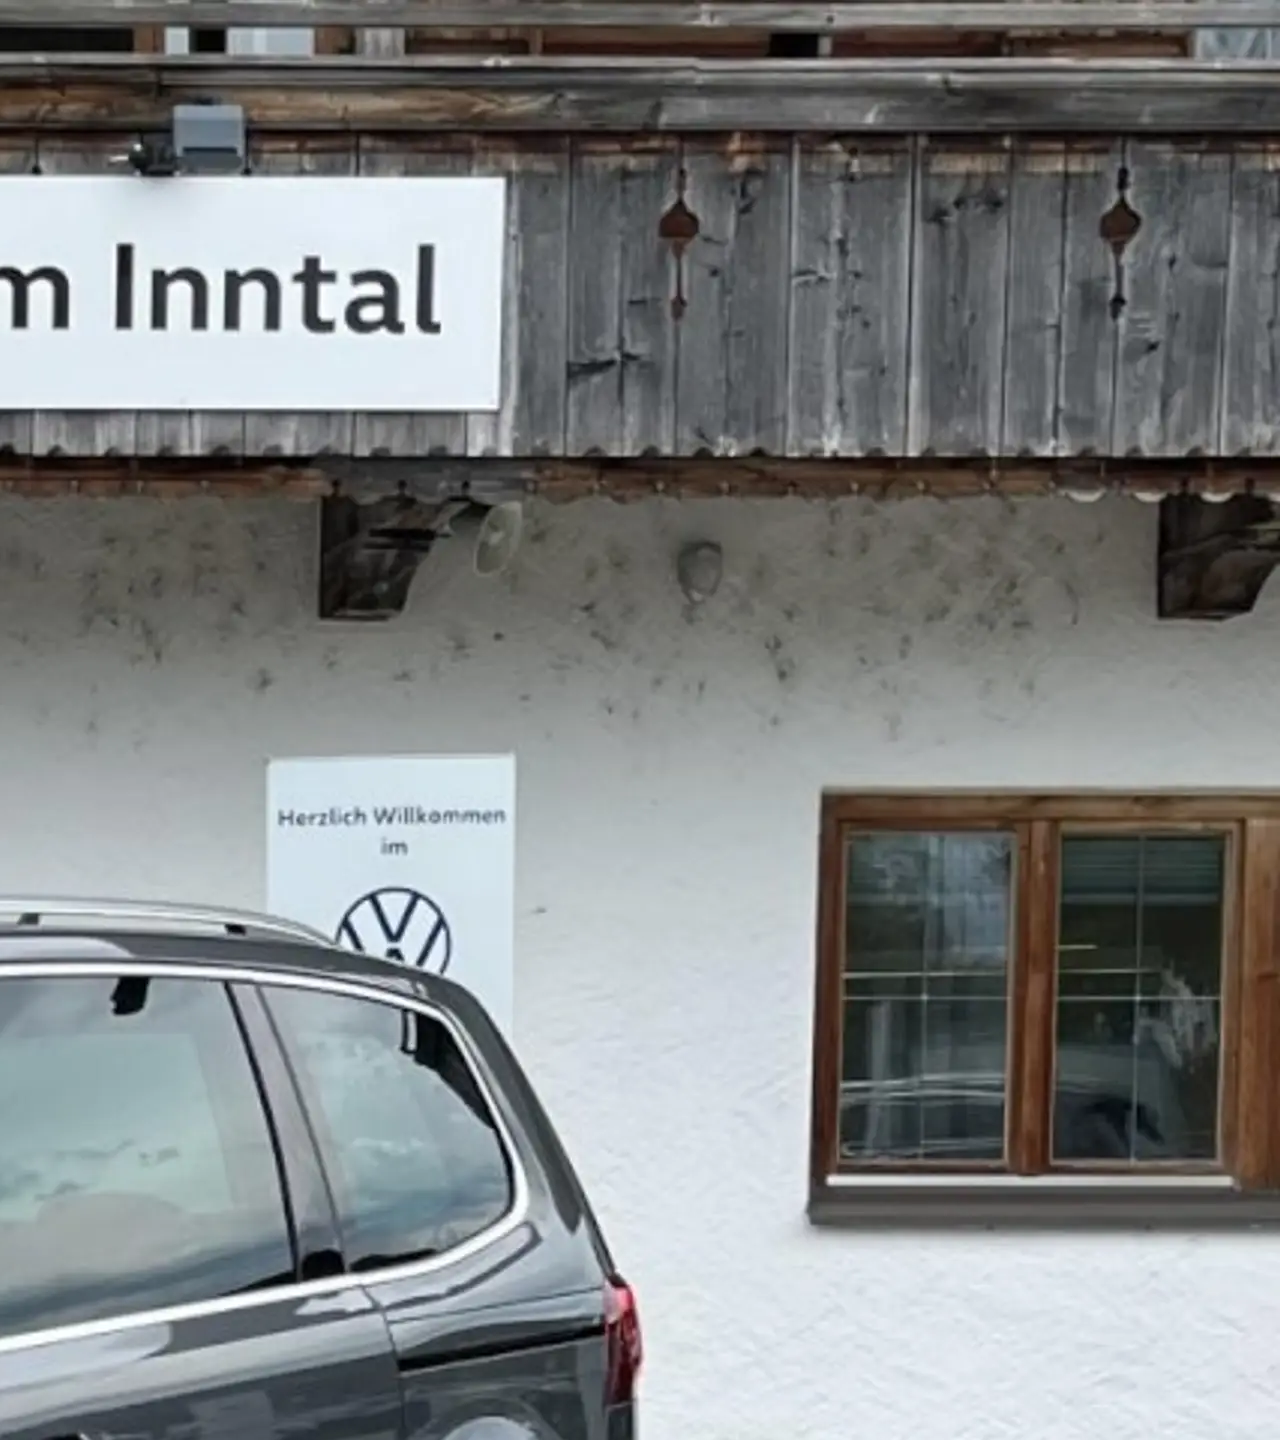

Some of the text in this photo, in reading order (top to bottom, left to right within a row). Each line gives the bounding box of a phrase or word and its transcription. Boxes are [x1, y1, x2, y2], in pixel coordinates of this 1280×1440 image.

[115, 243, 441, 334] Inntal
[277, 805, 506, 827] Herzlich Willkommen
[380, 837, 409, 855] im
